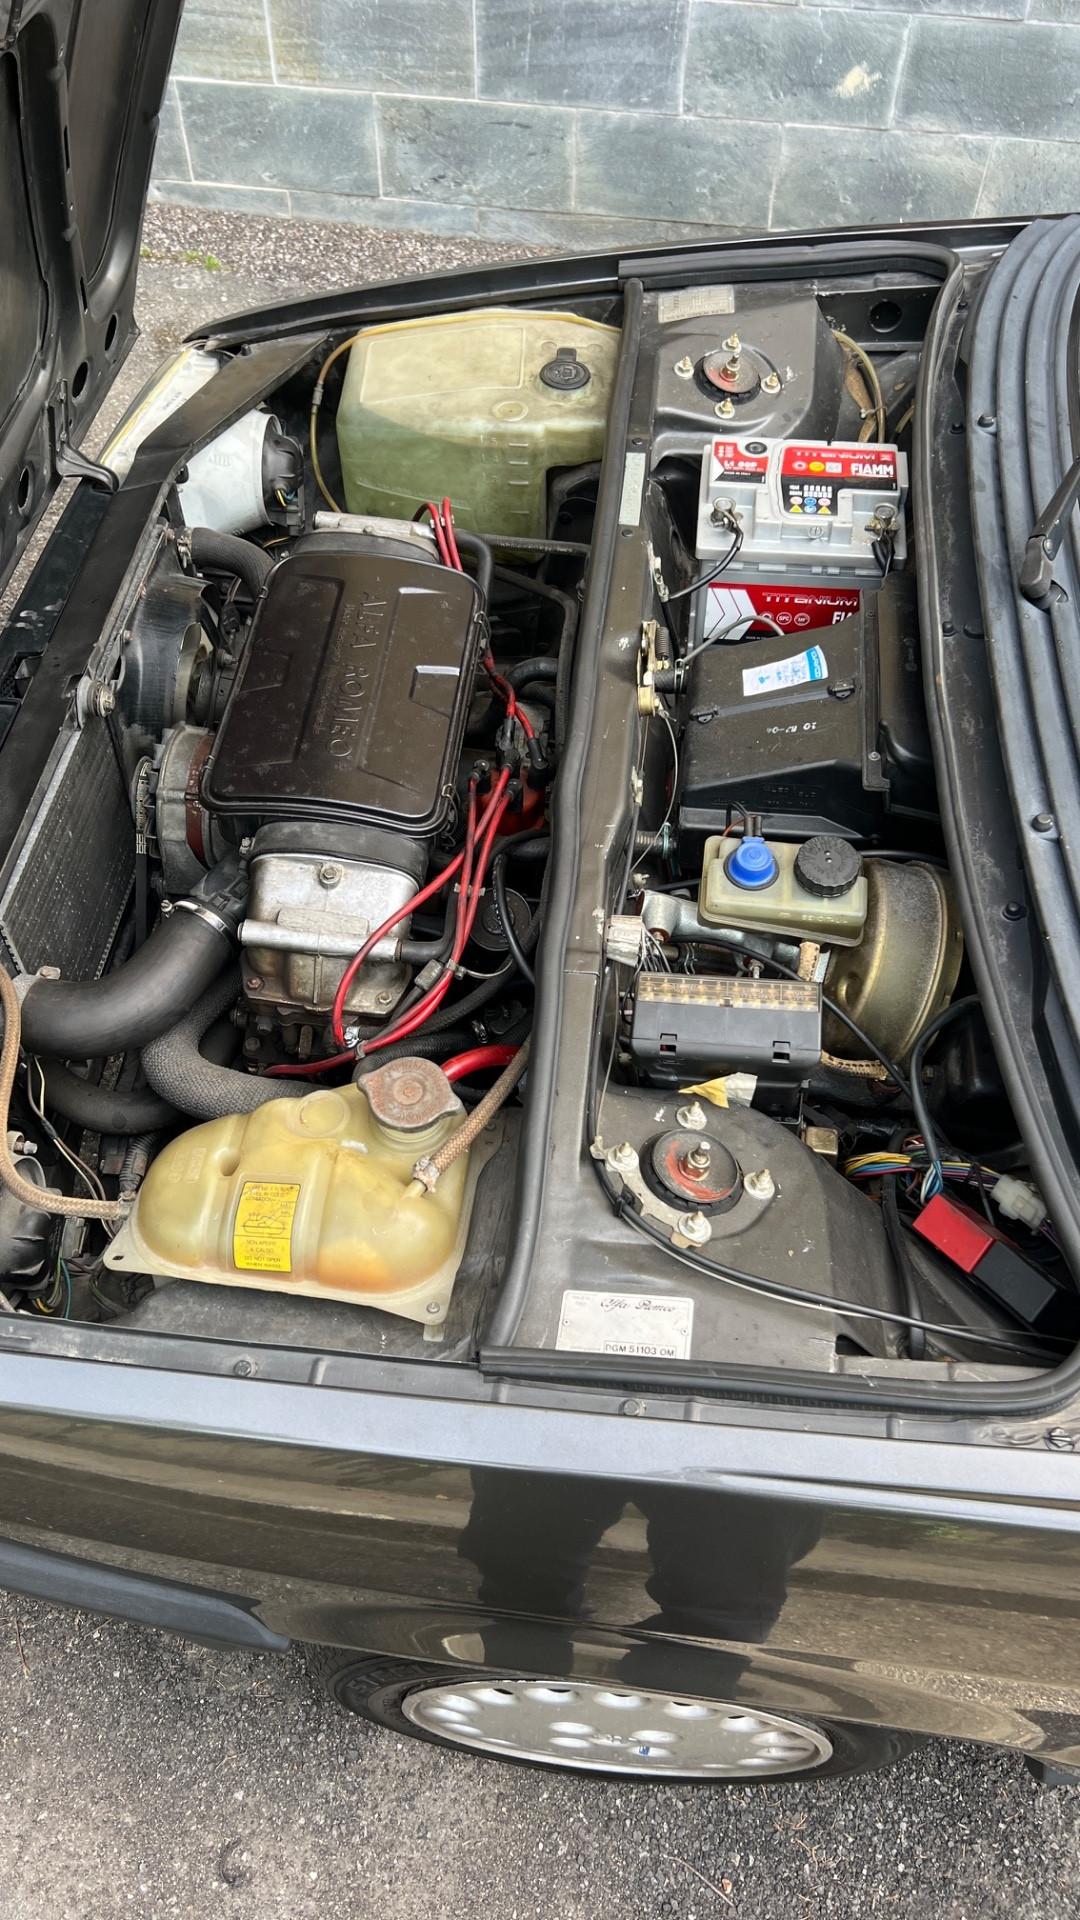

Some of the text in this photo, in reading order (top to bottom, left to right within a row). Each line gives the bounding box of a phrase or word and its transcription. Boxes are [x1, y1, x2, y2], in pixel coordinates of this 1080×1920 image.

[850, 462, 894, 477] FIAMM
[351, 591, 388, 649] ALFA
[328, 662, 370, 757] ROMEO
[600, 1298, 631, 1313] Alfa
[635, 1299, 676, 1312] Romeo
[629, 1344, 657, 1355] 51103
